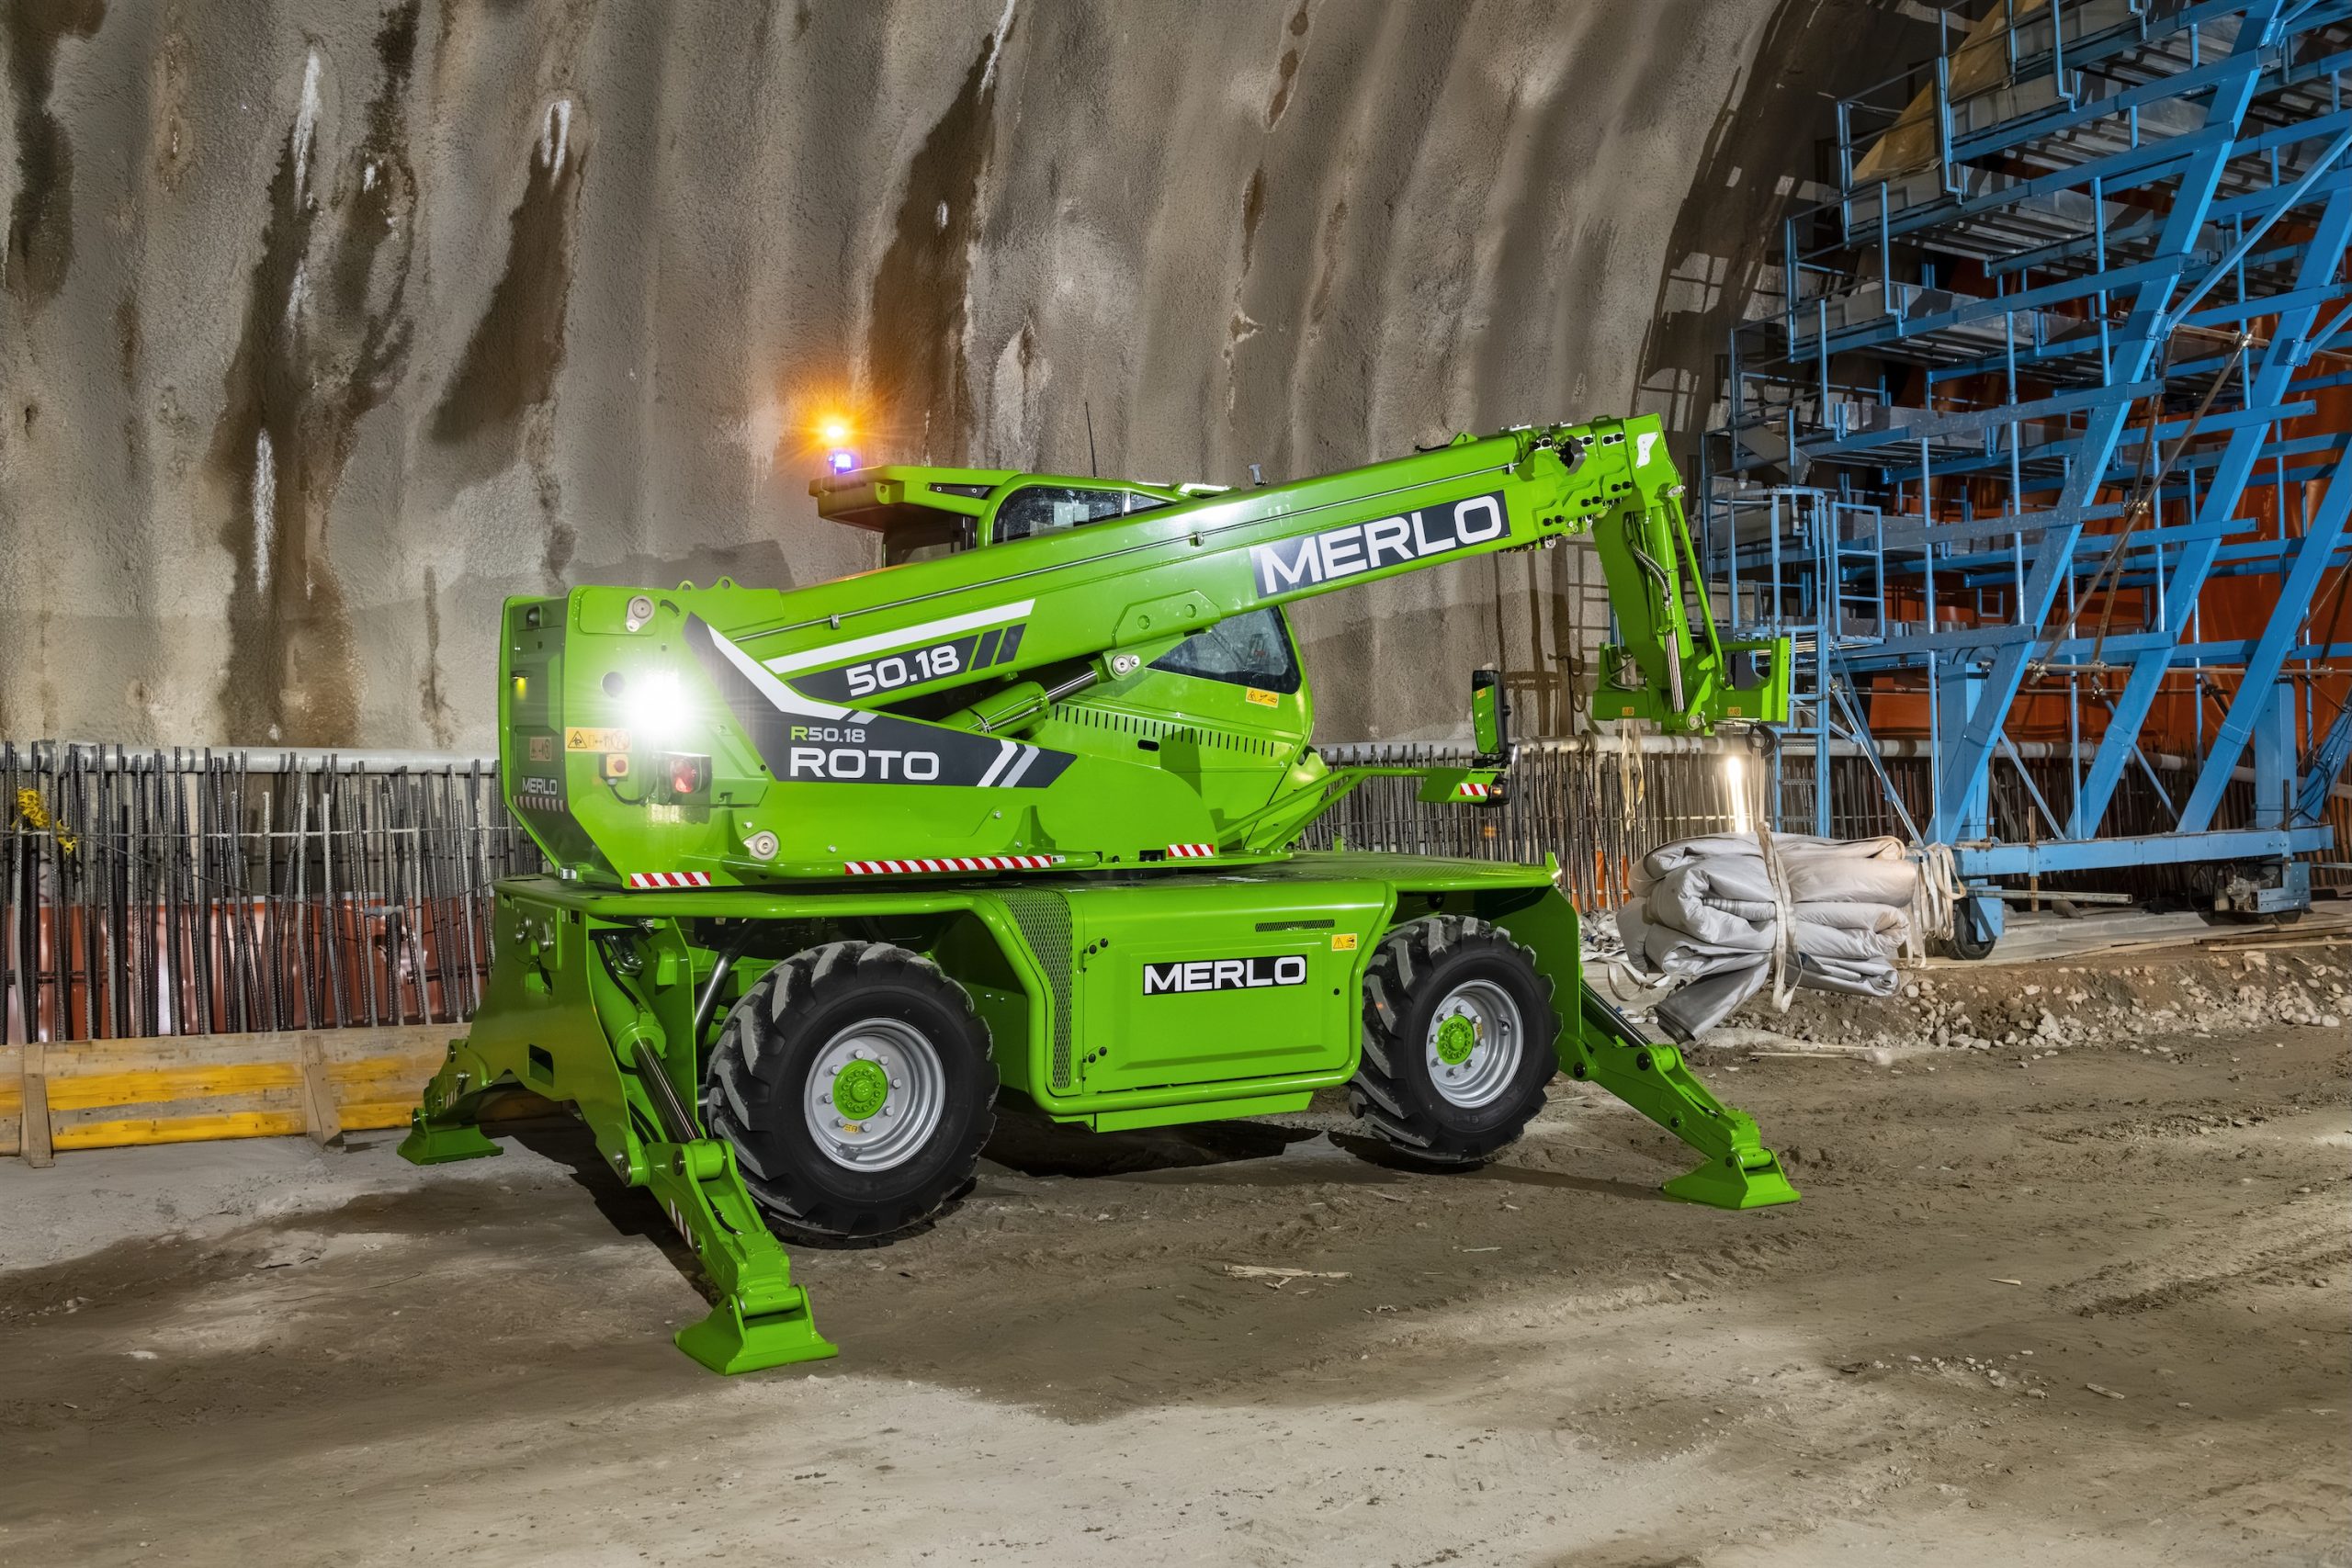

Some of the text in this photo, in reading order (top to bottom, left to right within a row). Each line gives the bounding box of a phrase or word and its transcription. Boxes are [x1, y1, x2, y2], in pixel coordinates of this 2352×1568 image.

[1260, 495, 1501, 593] MERLO
[845, 645, 960, 696] 50.18
[790, 726, 865, 743] R50.18
[789, 747, 940, 781] ROTO
[522, 776, 558, 795] MERLO
[1144, 955, 1306, 994] MERLO
